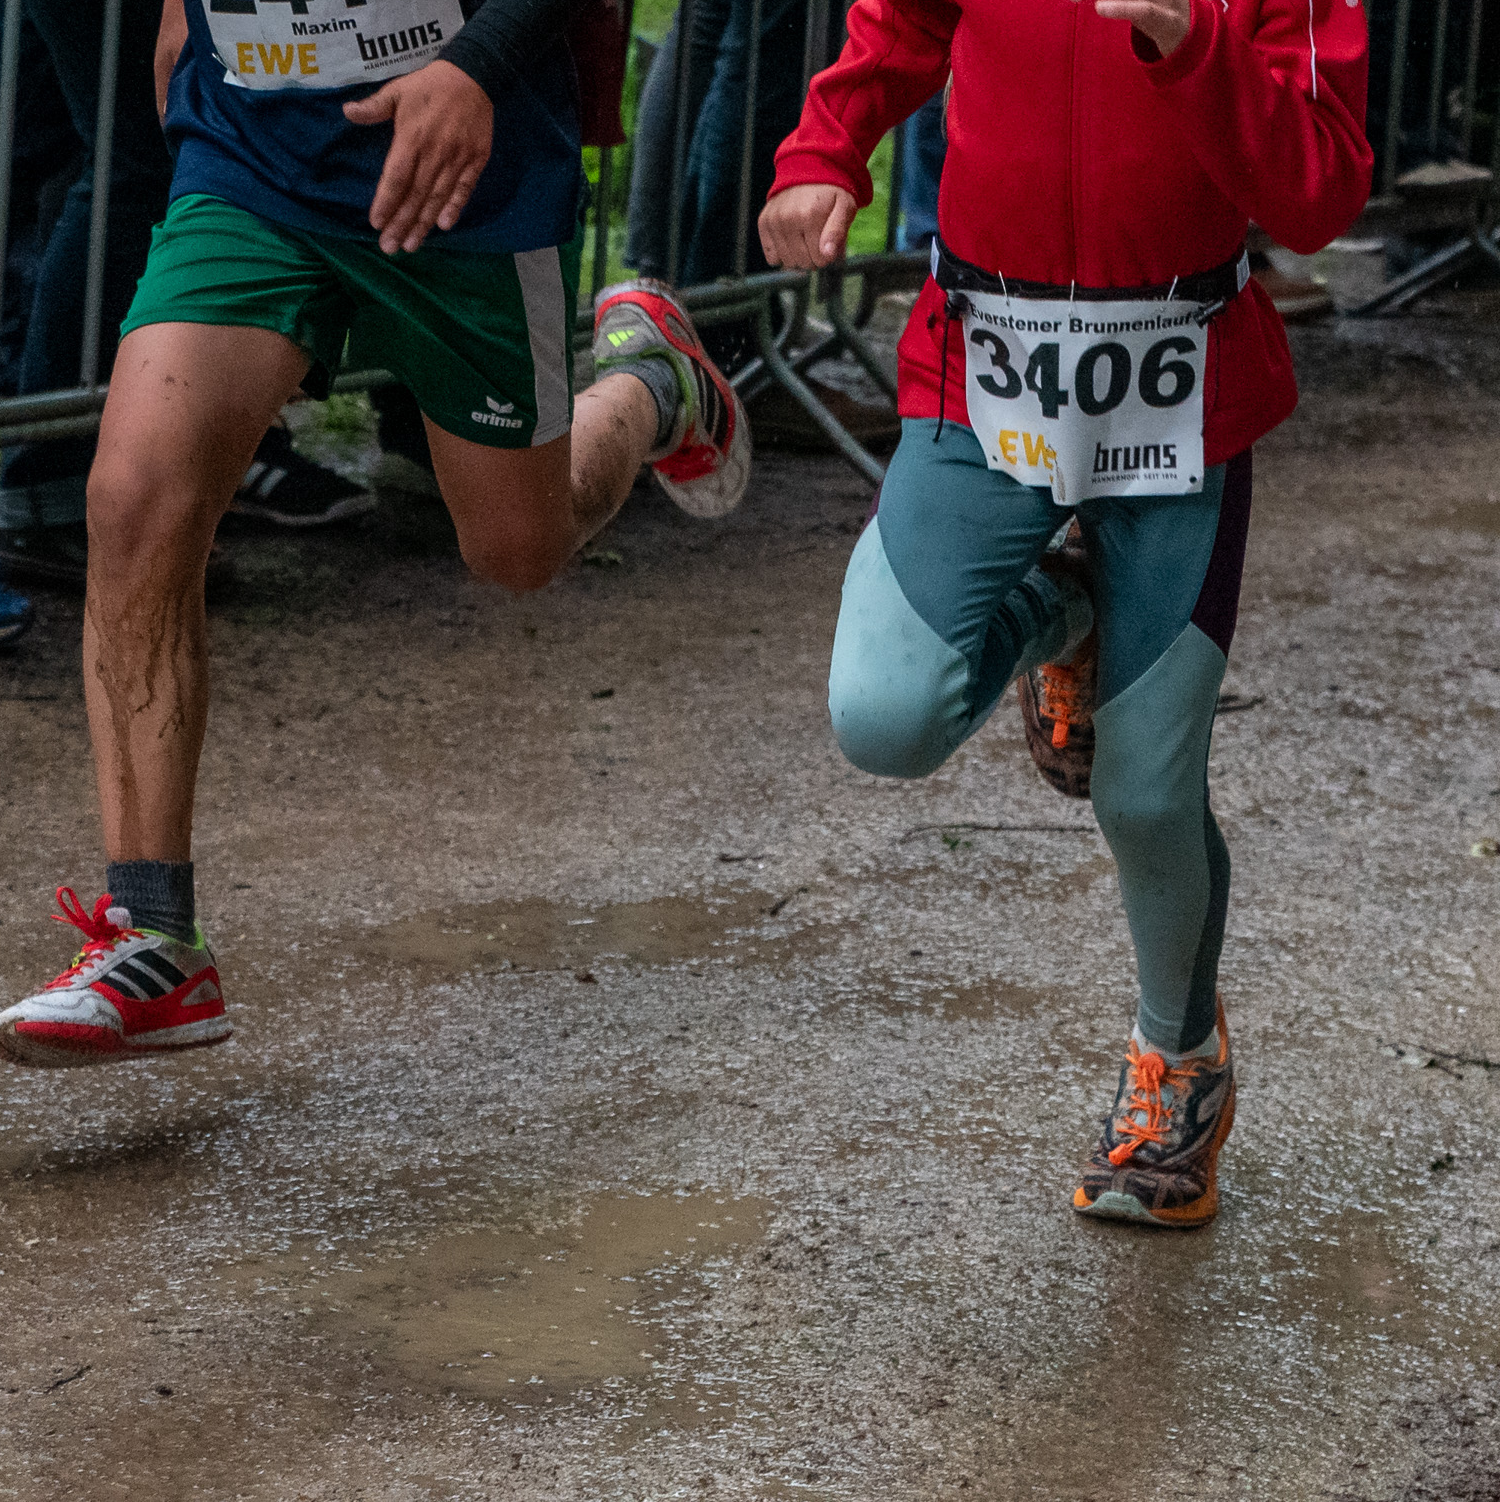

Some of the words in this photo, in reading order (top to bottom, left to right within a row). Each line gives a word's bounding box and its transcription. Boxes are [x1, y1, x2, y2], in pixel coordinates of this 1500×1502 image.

[291, 17, 358, 37] Maxim
[355, 19, 444, 62] bruns
[235, 41, 321, 76] EWE
[969, 303, 1062, 333] Everstener
[1069, 310, 1193, 334] Brunnenlauf
[969, 328, 1199, 420] 3406
[470, 410, 524, 429] erima
[1092, 441, 1177, 473] bruns
